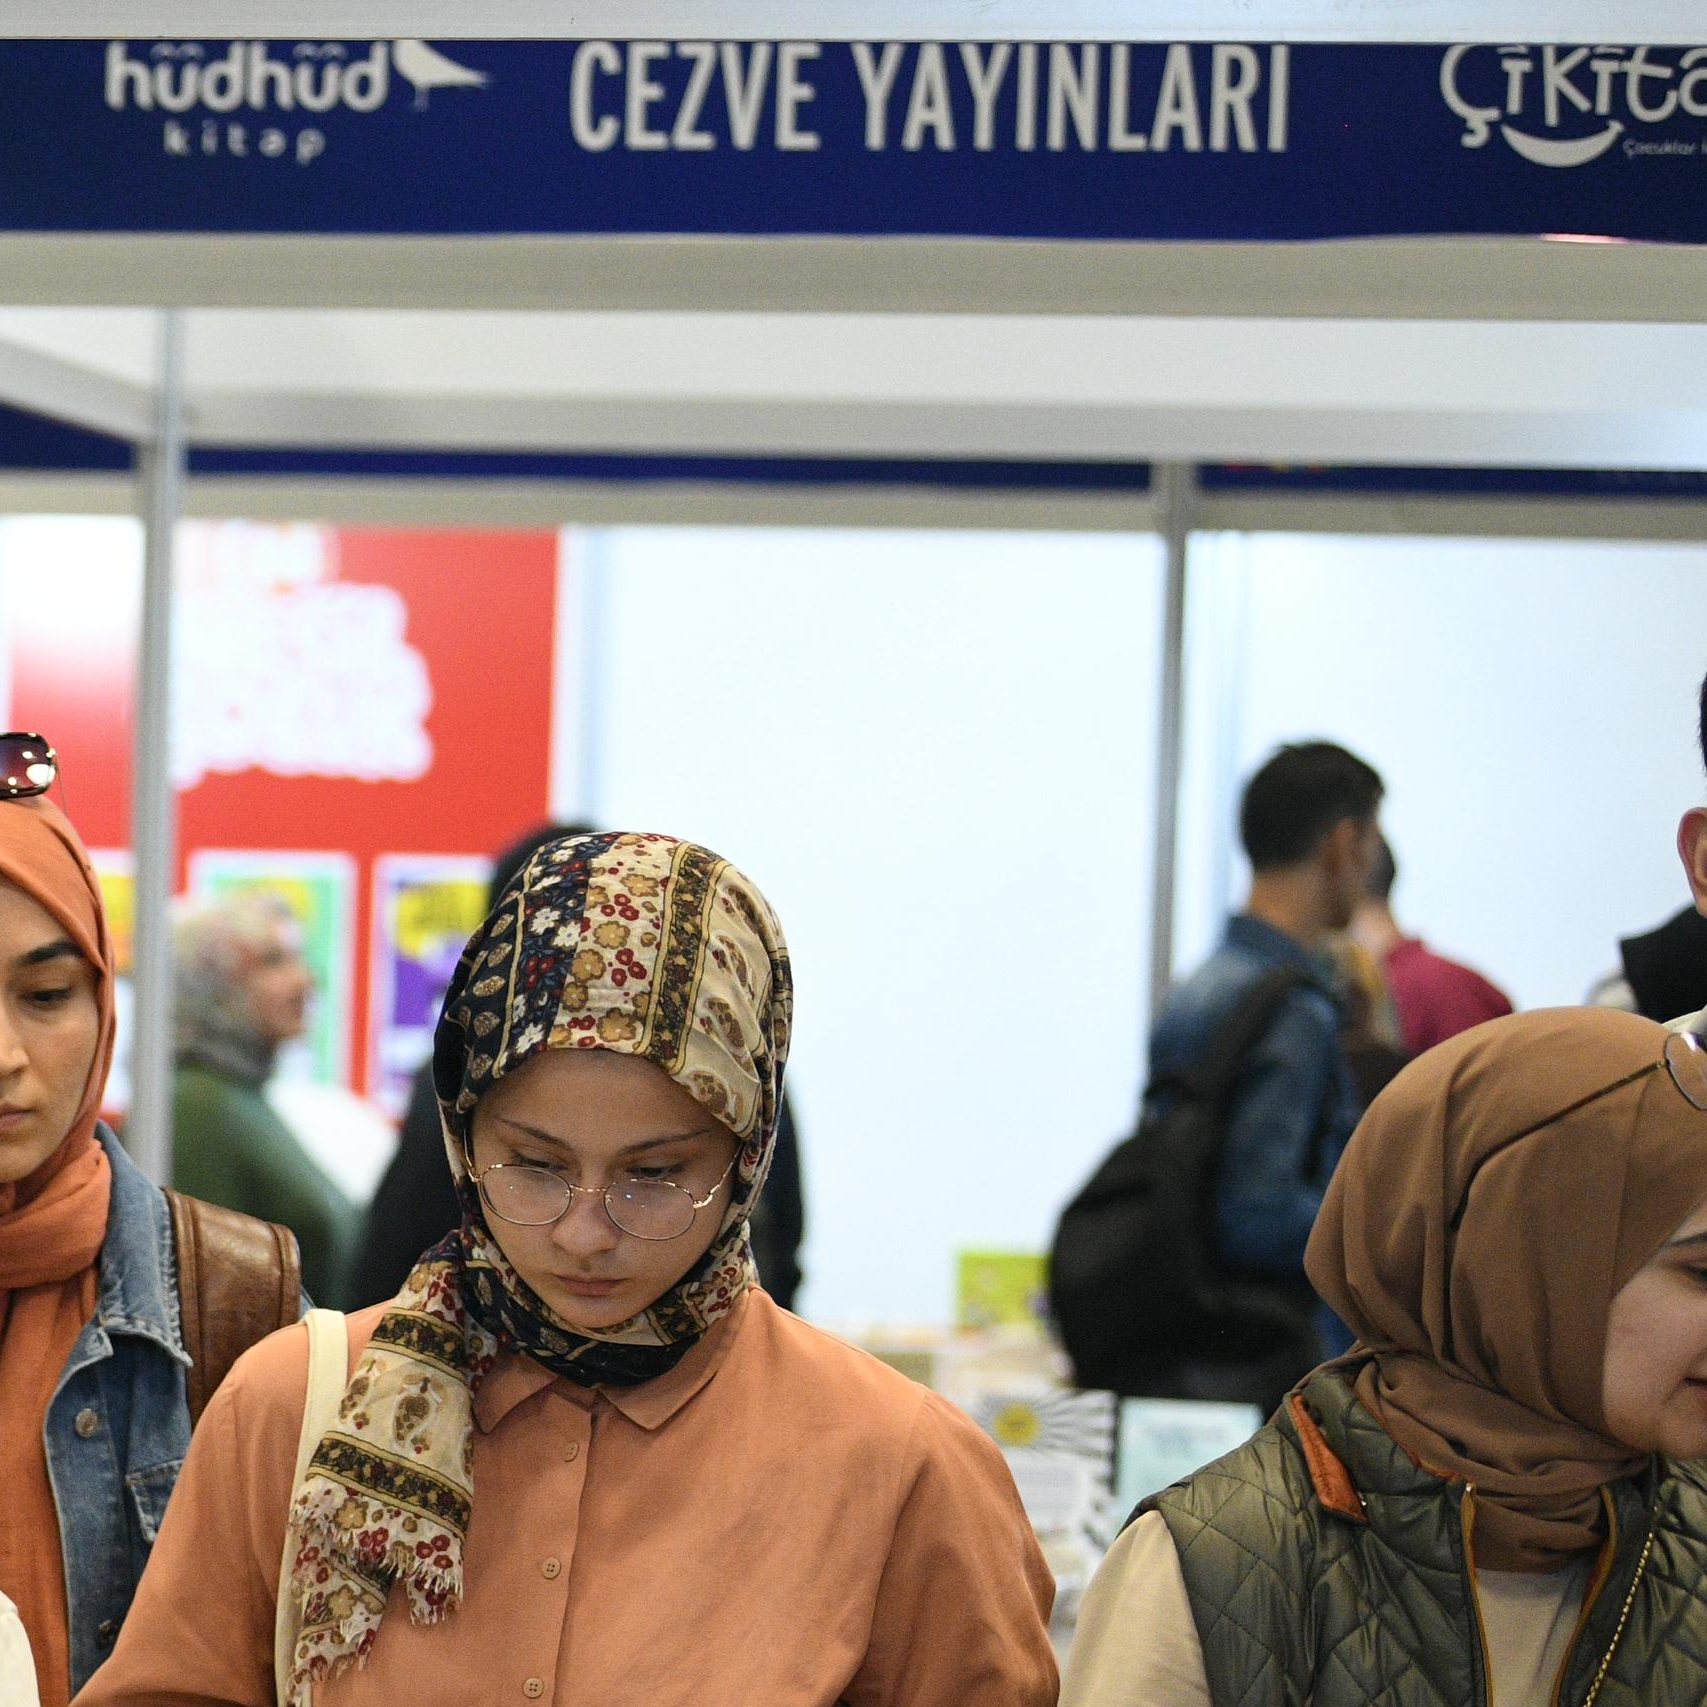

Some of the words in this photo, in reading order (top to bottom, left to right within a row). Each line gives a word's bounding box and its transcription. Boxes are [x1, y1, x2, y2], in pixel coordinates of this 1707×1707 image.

[104, 40, 388, 111] hüdhüd
[569, 41, 822, 153] CEZVE
[852, 43, 1289, 153] YAYINLARI
